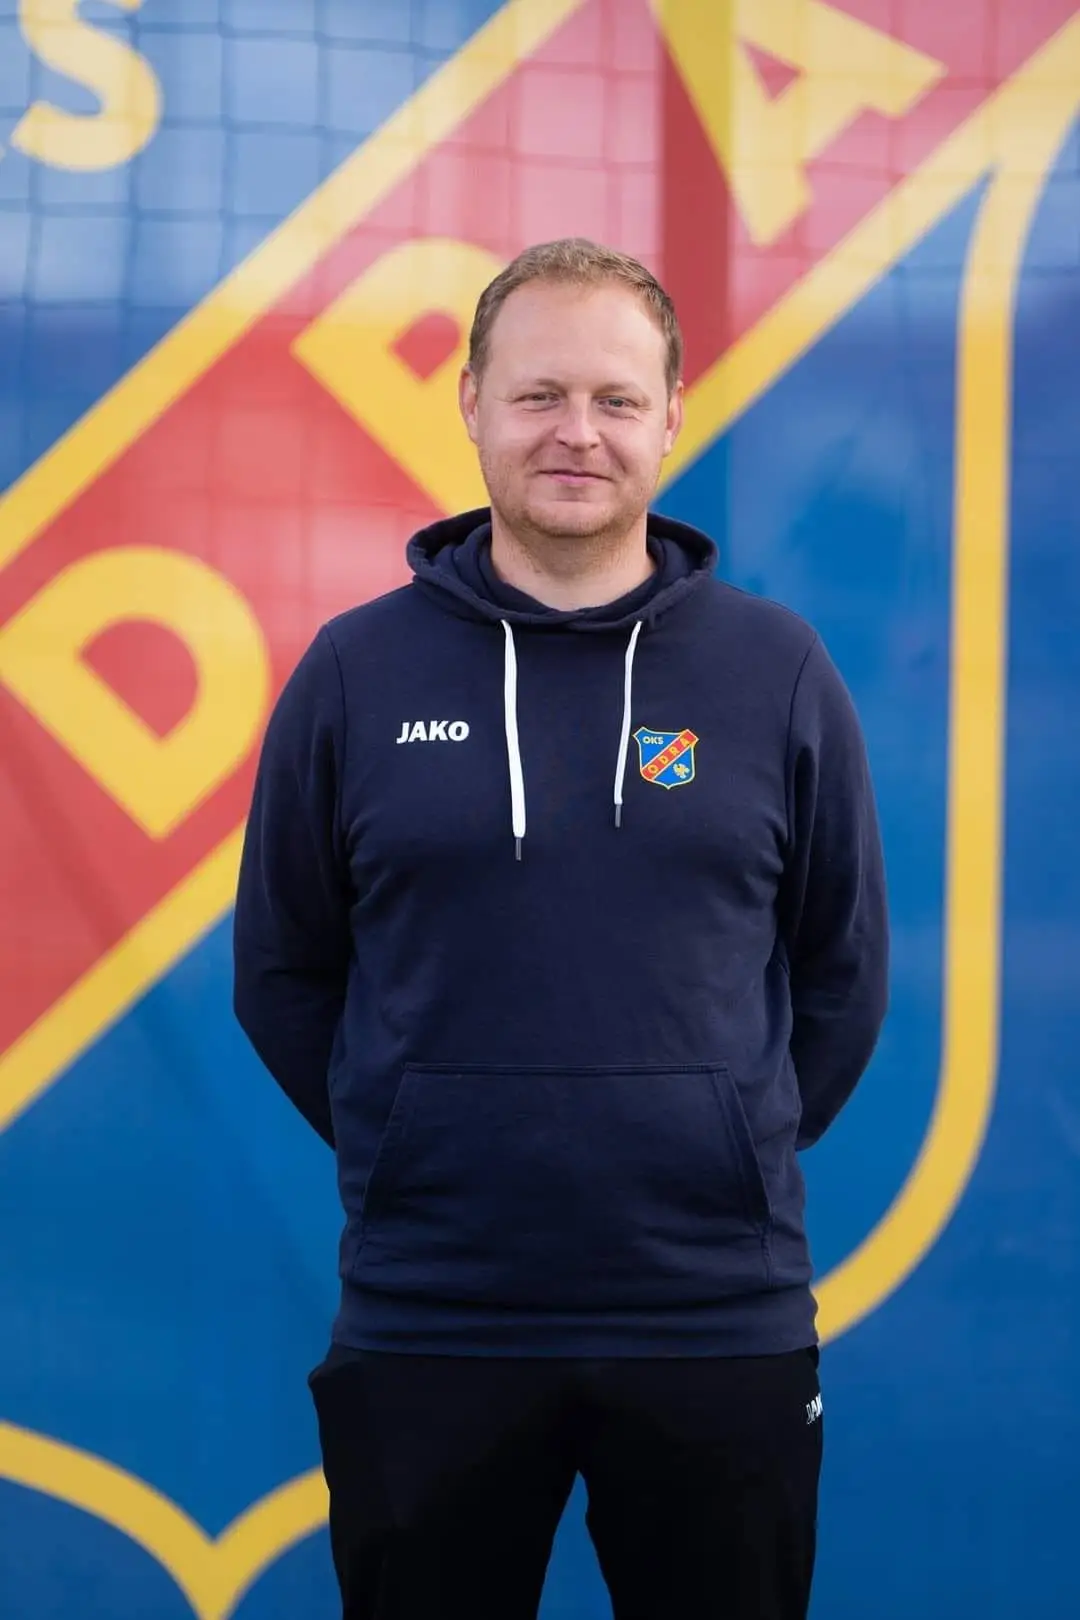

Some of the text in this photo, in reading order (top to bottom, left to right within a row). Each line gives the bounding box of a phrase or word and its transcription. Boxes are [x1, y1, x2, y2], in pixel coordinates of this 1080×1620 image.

[396, 720, 470, 744] JAKO
[642, 735, 665, 745] OKS
[647, 738, 692, 774] ODRA
